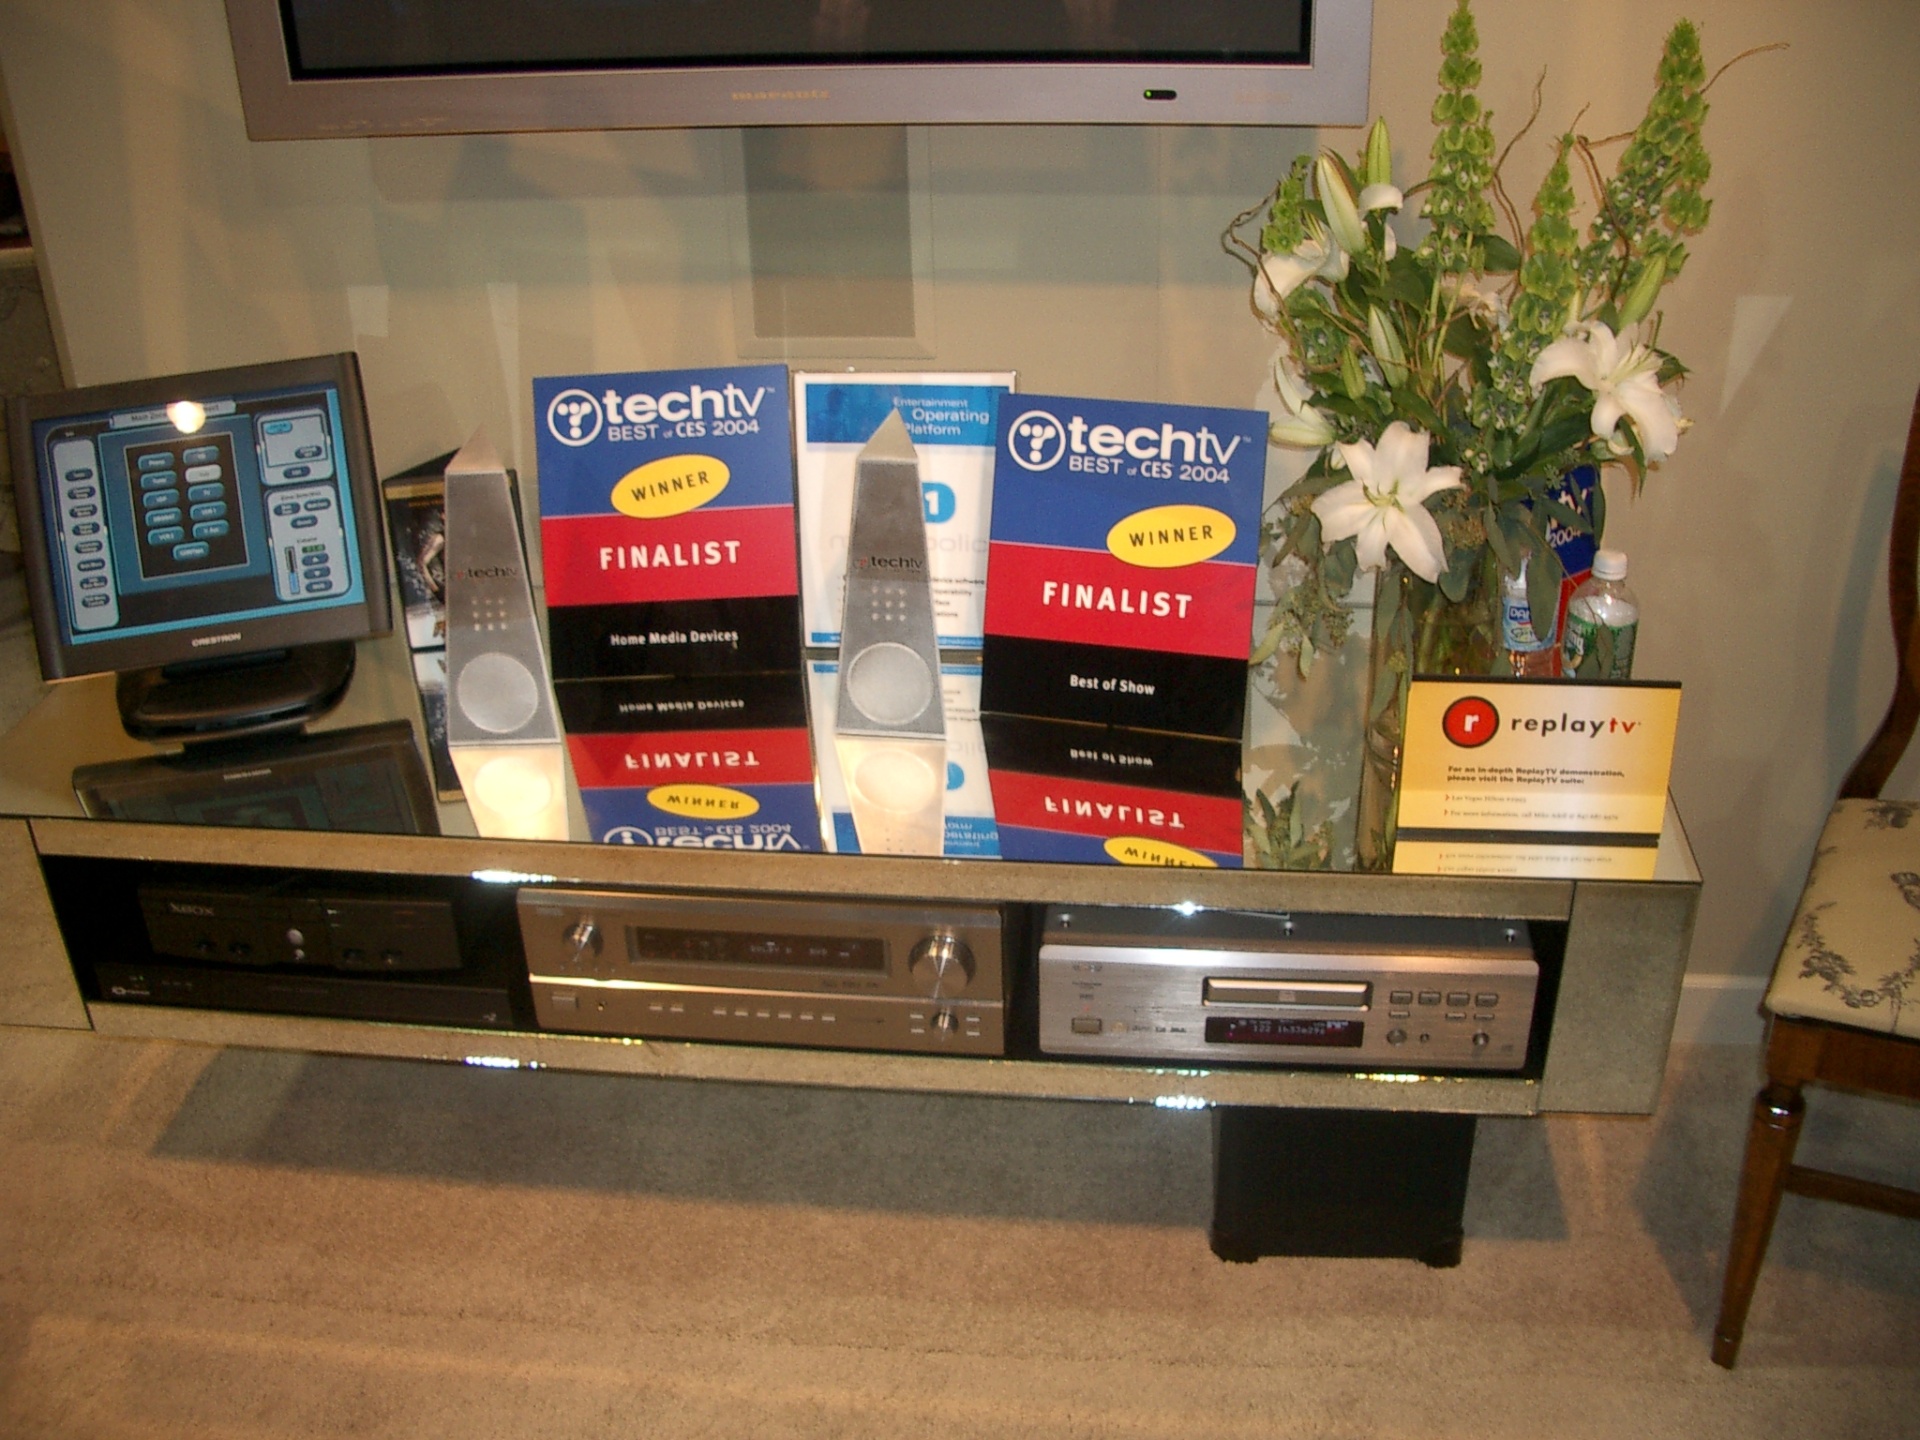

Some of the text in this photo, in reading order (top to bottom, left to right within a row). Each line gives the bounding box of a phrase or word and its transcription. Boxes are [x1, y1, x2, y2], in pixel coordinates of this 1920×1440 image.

[602, 383, 765, 425] techtv
[893, 397, 968, 408] Entertainment
[911, 407, 990, 426] Operating
[607, 424, 660, 442] BEST
[675, 422, 706, 438] CES
[712, 419, 761, 436] 2004
[1068, 415, 1242, 465] techtv
[1069, 454, 1125, 475] BEST
[1140, 460, 1174, 479] CES
[1179, 464, 1231, 484] 2004
[630, 470, 710, 502] WINNER
[1128, 524, 1214, 547] WINNER
[599, 540, 741, 571] FINALIST
[1042, 579, 1193, 619] FINALIST
[609, 629, 739, 646] Home Media Devices
[1069, 674, 1156, 696] Best of Show
[1511, 712, 1637, 738] replaytv
[1447, 774, 1477, 783] please
[1479, 774, 1498, 783] visit
[1500, 775, 1514, 783] the
[1516, 776, 1558, 786] ReplayTV
[1448, 765, 1462, 773] For
[1516, 766, 1558, 776] ReplayTV
[1559, 768, 1626, 778] demonstration,
